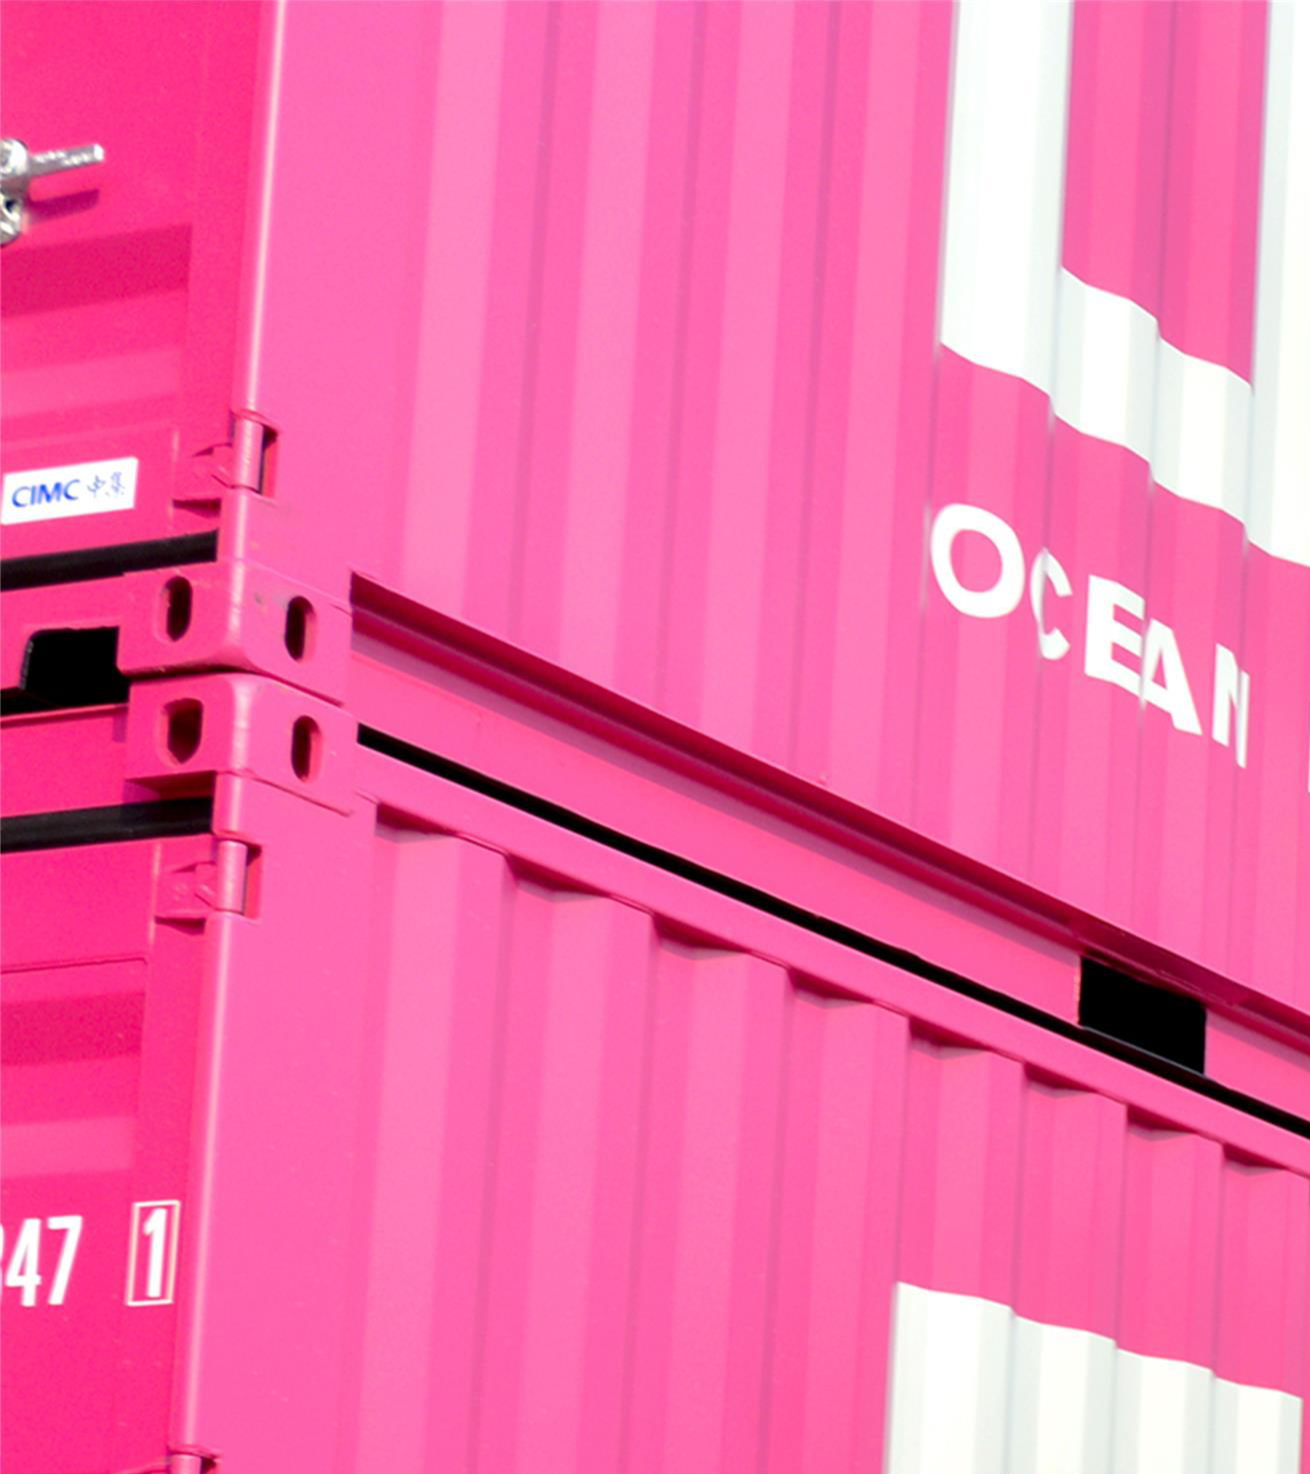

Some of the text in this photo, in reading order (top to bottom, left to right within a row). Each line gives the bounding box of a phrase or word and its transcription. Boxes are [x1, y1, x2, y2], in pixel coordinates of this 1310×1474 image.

[12, 479, 80, 508] CIMC
[930, 503, 1249, 767] OCEAN
[0, 1214, 83, 1307] 47
